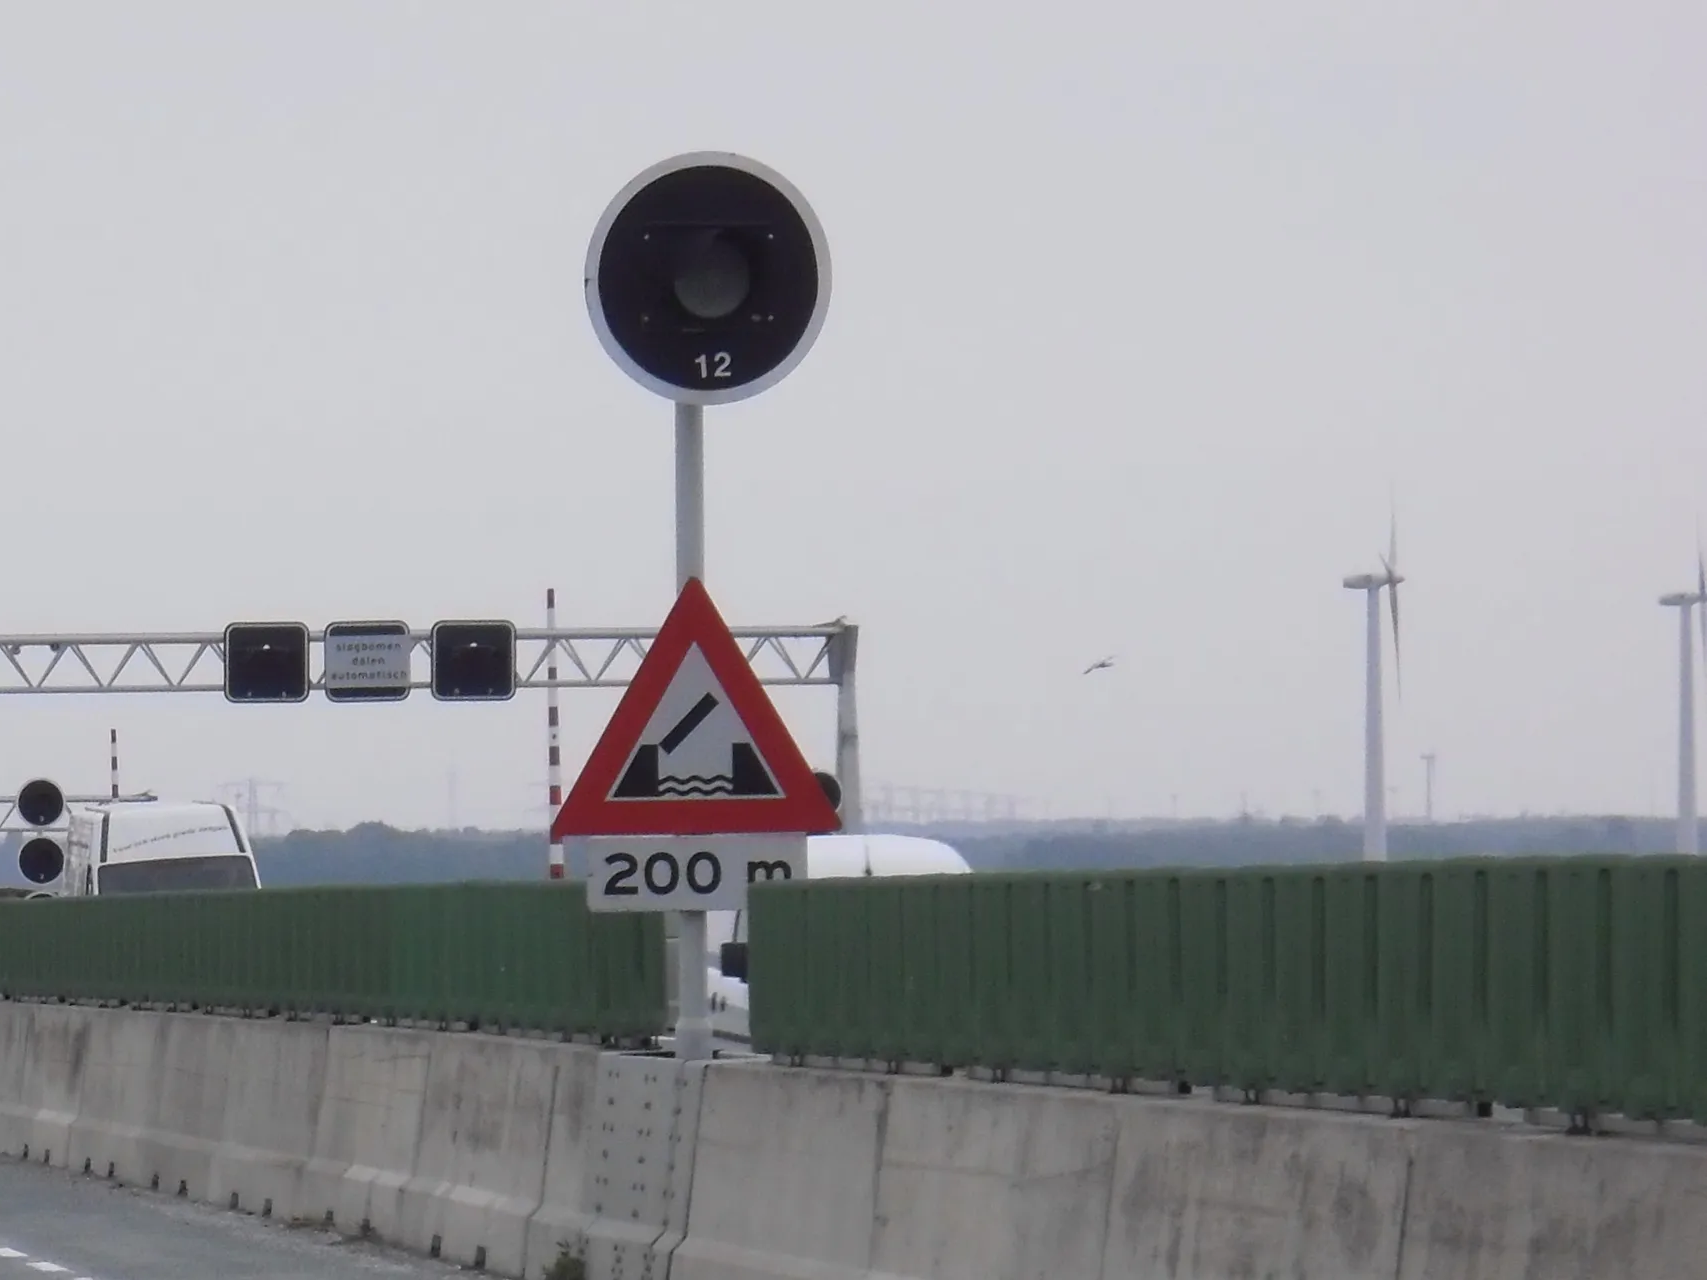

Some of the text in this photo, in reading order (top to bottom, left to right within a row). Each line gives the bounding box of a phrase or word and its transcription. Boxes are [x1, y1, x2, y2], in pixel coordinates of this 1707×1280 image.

[695, 351, 732, 379] 12
[352, 656, 386, 666] dalen
[604, 851, 792, 895] 200 m
